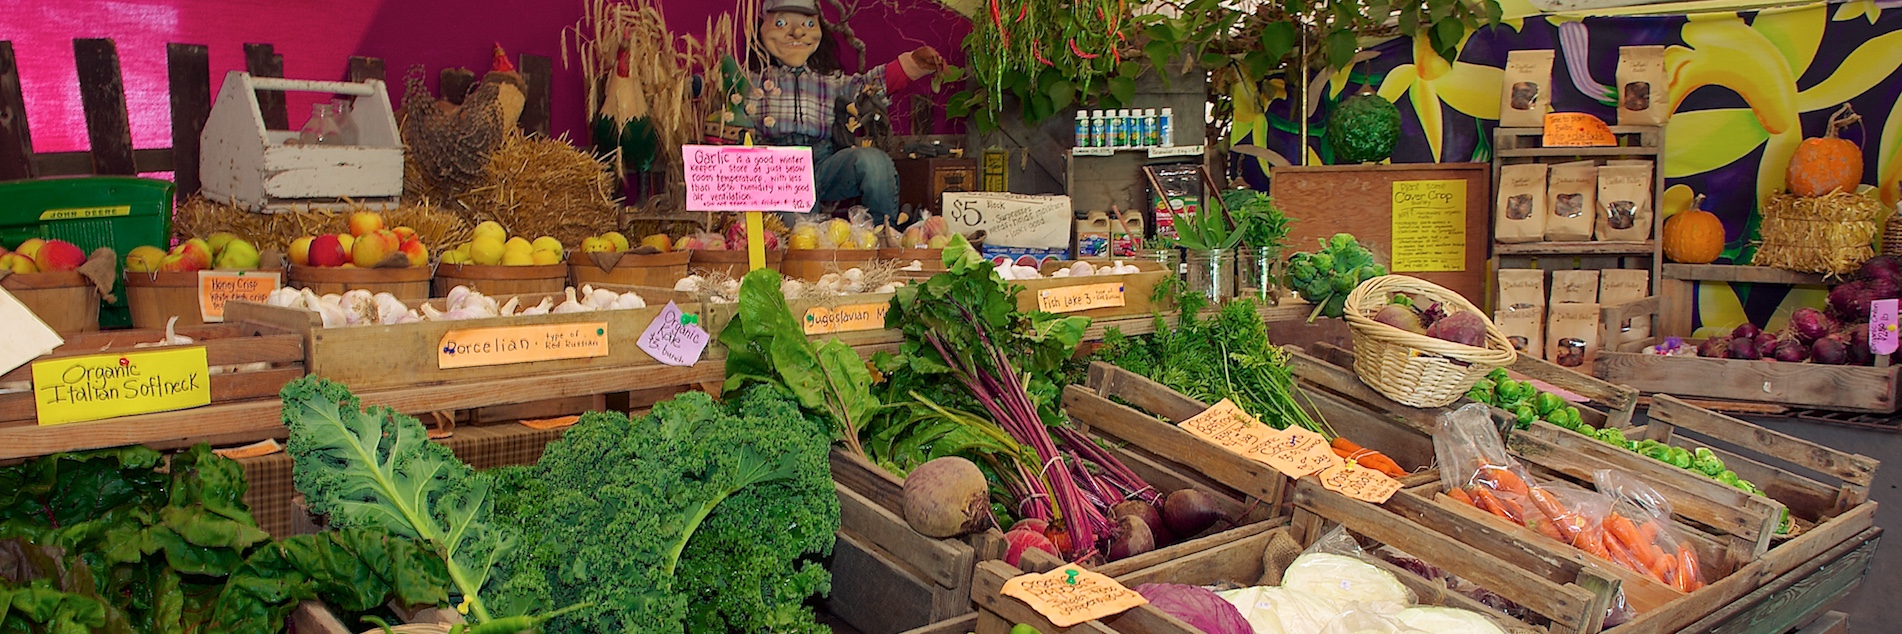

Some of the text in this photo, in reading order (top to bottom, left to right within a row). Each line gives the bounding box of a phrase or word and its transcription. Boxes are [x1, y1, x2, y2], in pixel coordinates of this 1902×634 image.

[694, 149, 730, 165] Garlic
[745, 155, 751, 163] a
[754, 155, 774, 166] good
[779, 154, 804, 164] winter
[728, 164, 748, 173] store
[765, 164, 782, 174] just
[692, 174, 713, 182] room
[770, 174, 787, 182] with
[691, 183, 710, 192] than
[777, 184, 793, 192] with
[793, 184, 810, 195] good
[1394, 190, 1453, 204] Cover Crop
[50, 208, 117, 218] JOHN DEERE
[211, 278, 235, 293] Honey
[1043, 293, 1092, 310] Fish Lake 3
[664, 310, 700, 344] Organic
[546, 329, 579, 342] type of
[656, 323, 681, 349] Kale
[545, 339, 598, 350] Red Russian
[62, 363, 141, 391] Organic
[40, 382, 119, 405] Italian
